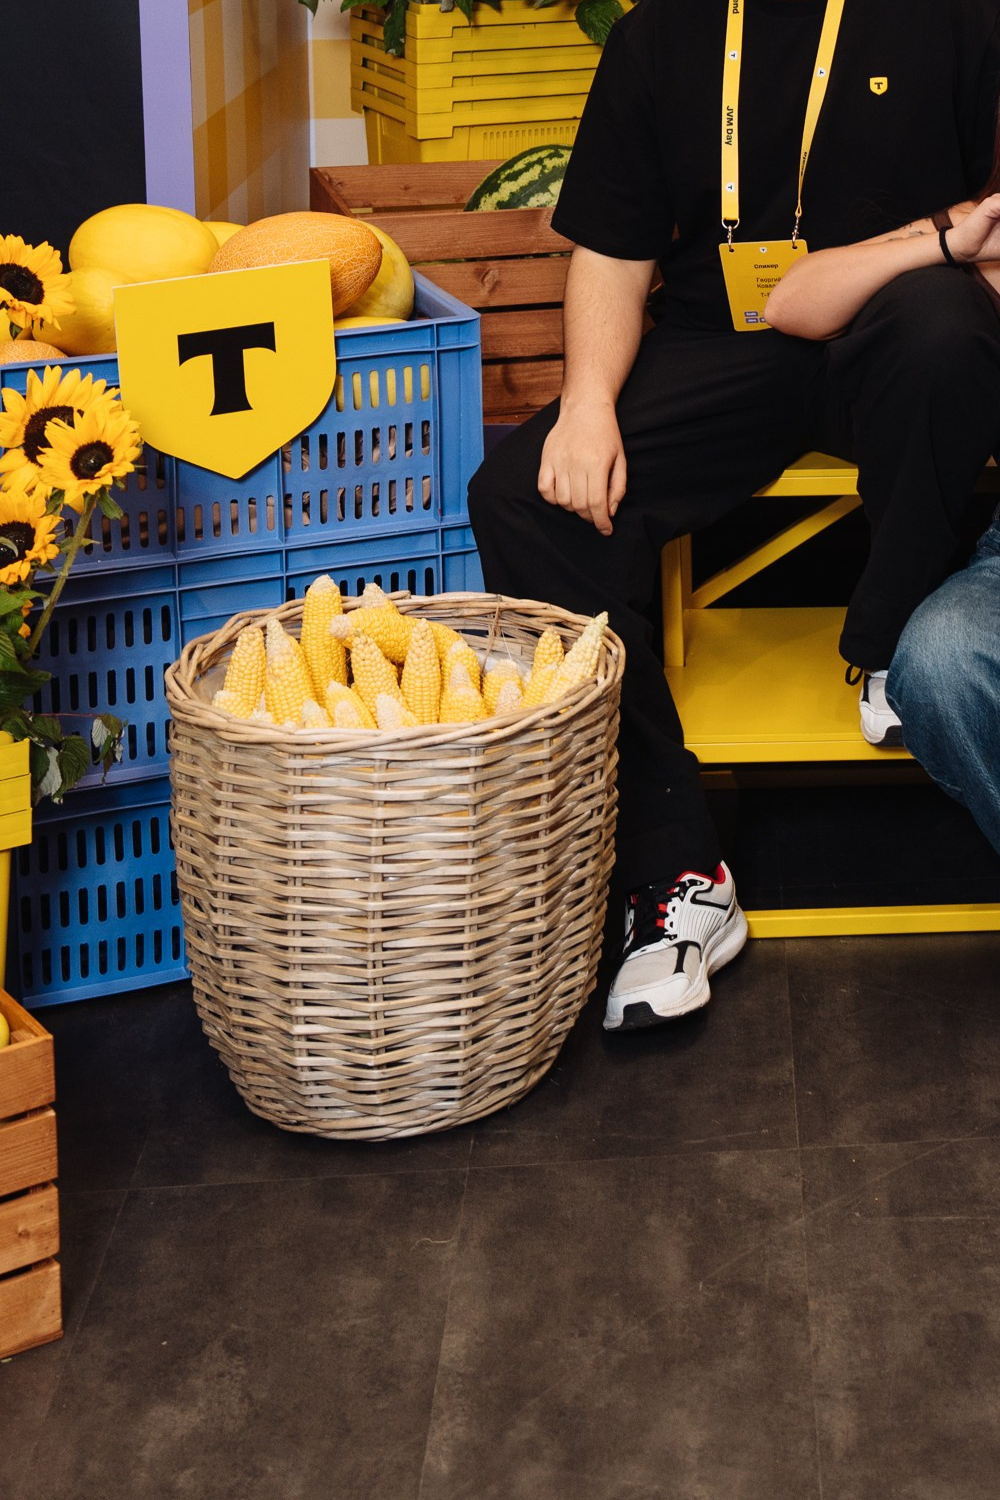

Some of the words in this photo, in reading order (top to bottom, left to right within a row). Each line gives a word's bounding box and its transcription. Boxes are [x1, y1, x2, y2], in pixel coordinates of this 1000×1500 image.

[874, 81, 883, 90] T
[726, 105, 734, 127] JVM
[724, 128, 733, 146] Day
[177, 321, 276, 416] T
